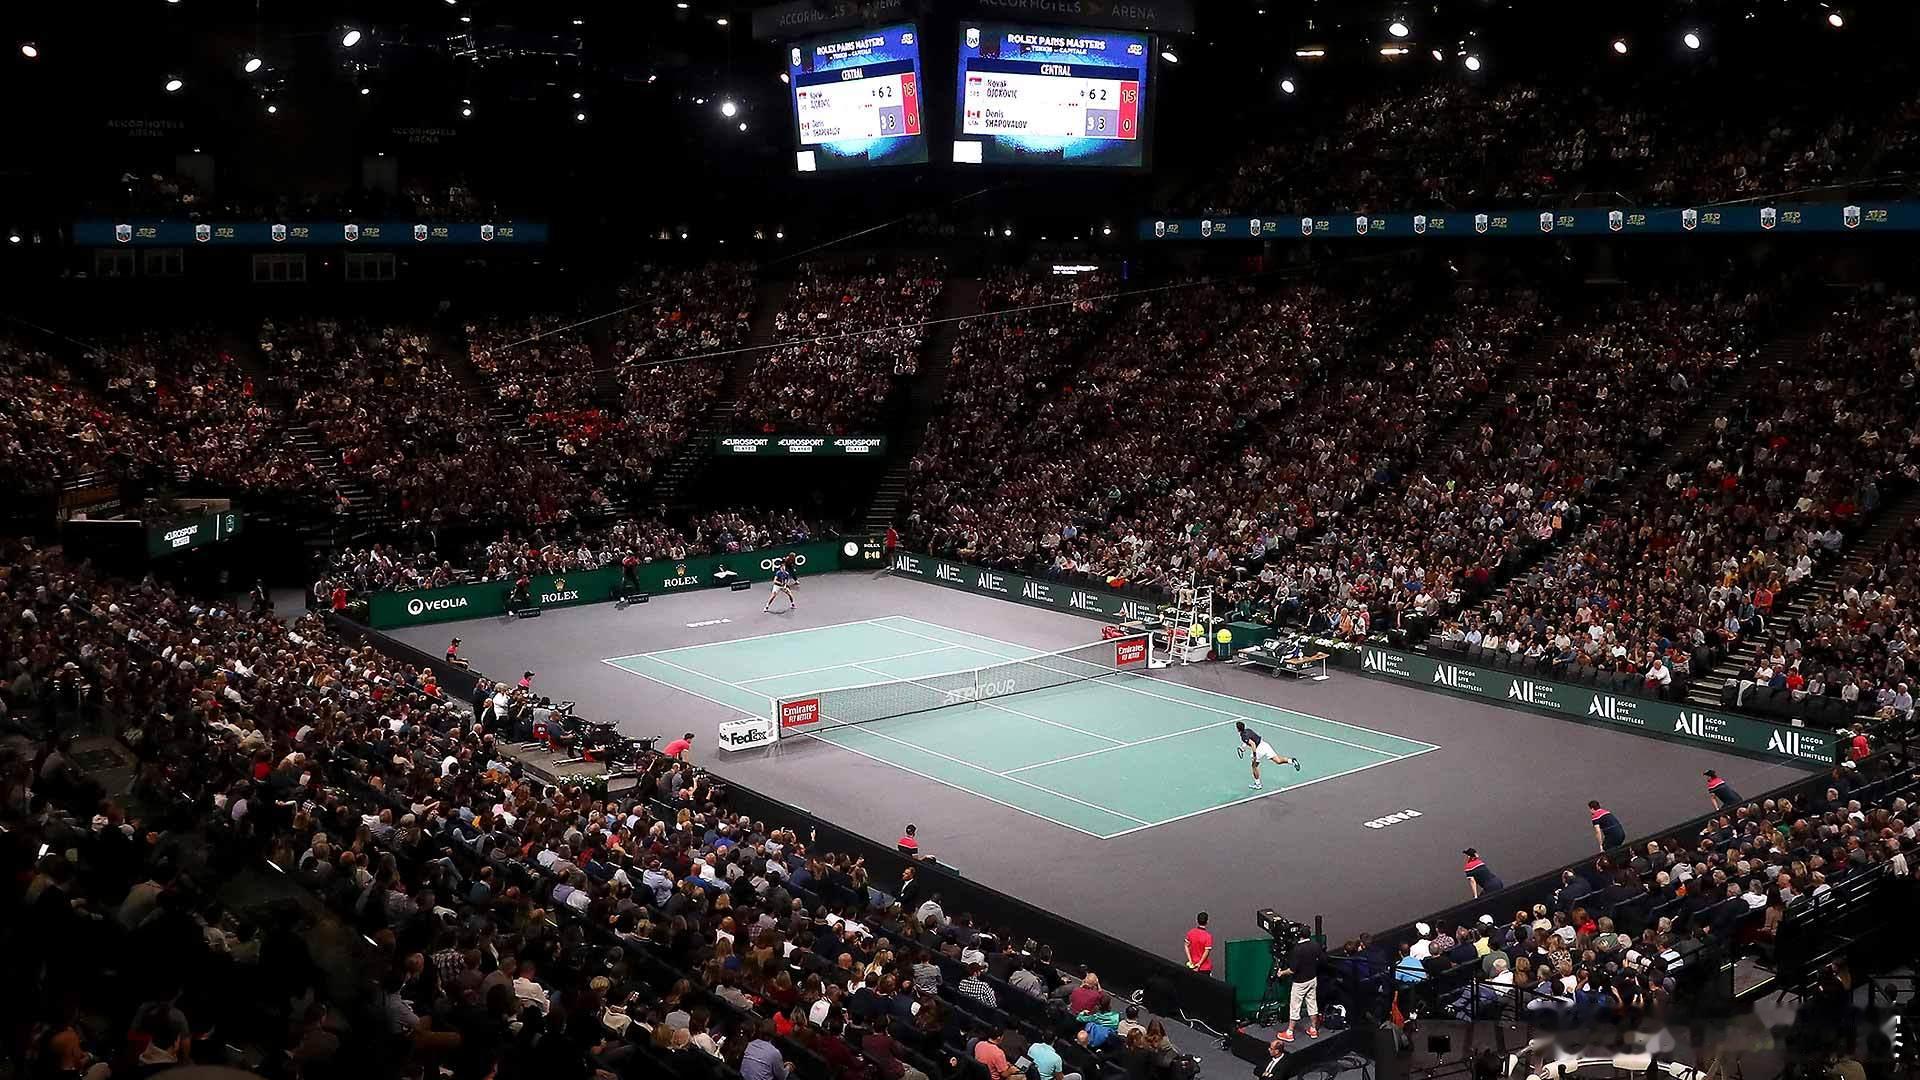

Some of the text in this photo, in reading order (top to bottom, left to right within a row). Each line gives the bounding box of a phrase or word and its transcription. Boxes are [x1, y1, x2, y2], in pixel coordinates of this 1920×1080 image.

[1111, 5, 1154, 18] ARENA
[1008, 34, 1106, 50] ROLEX PARIS MASTERS
[1040, 64, 1071, 76] CENTRAL
[878, 87, 884, 98] 6
[887, 86, 892, 97] 2
[903, 82, 915, 96] 15
[1089, 89, 1096, 99] 6
[1100, 89, 1106, 100] 2
[1121, 90, 1136, 103] 15
[985, 108, 1004, 118] Denis
[889, 114, 896, 129] 3
[985, 119, 1028, 129] SHAPOVALOV
[1098, 117, 1105, 130] 3
[1123, 118, 1131, 131] 0
[779, 439, 824, 447] EUROSPORT
[835, 439, 880, 447] EUROSPORT
[165, 524, 198, 541] EUROSPORT
[760, 554, 806, 572] opo
[663, 575, 698, 588] ROLEX
[541, 590, 579, 603] ROLEX
[1022, 581, 1038, 599] All
[424, 597, 468, 611] VEOLIA
[1069, 592, 1086, 609] All
[1118, 645, 1144, 655] Emirates
[1363, 650, 1387, 672] All
[1387, 667, 1409, 677] LIMITLESS
[1433, 664, 1458, 687] All
[979, 679, 1015, 699] TOUR
[1458, 682, 1482, 692] LIMITLESS
[1508, 679, 1534, 703] All
[784, 704, 816, 716] Emirates
[1534, 698, 1560, 708] LIMITLESS
[1588, 693, 1616, 719] All
[1617, 700, 1636, 708] ACCOR
[1616, 715, 1644, 725] LIMITLESS
[1674, 711, 1704, 737] All
[1705, 718, 1726, 726] ACCOR
[731, 728, 767, 745] FedEx
[1705, 732, 1735, 743] LIMITLESS
[1767, 729, 1799, 756] All
[1800, 736, 1823, 745] ACCOR
[1800, 752, 1832, 763] LIMITLESS
[1362, 809, 1423, 829] PARIS
